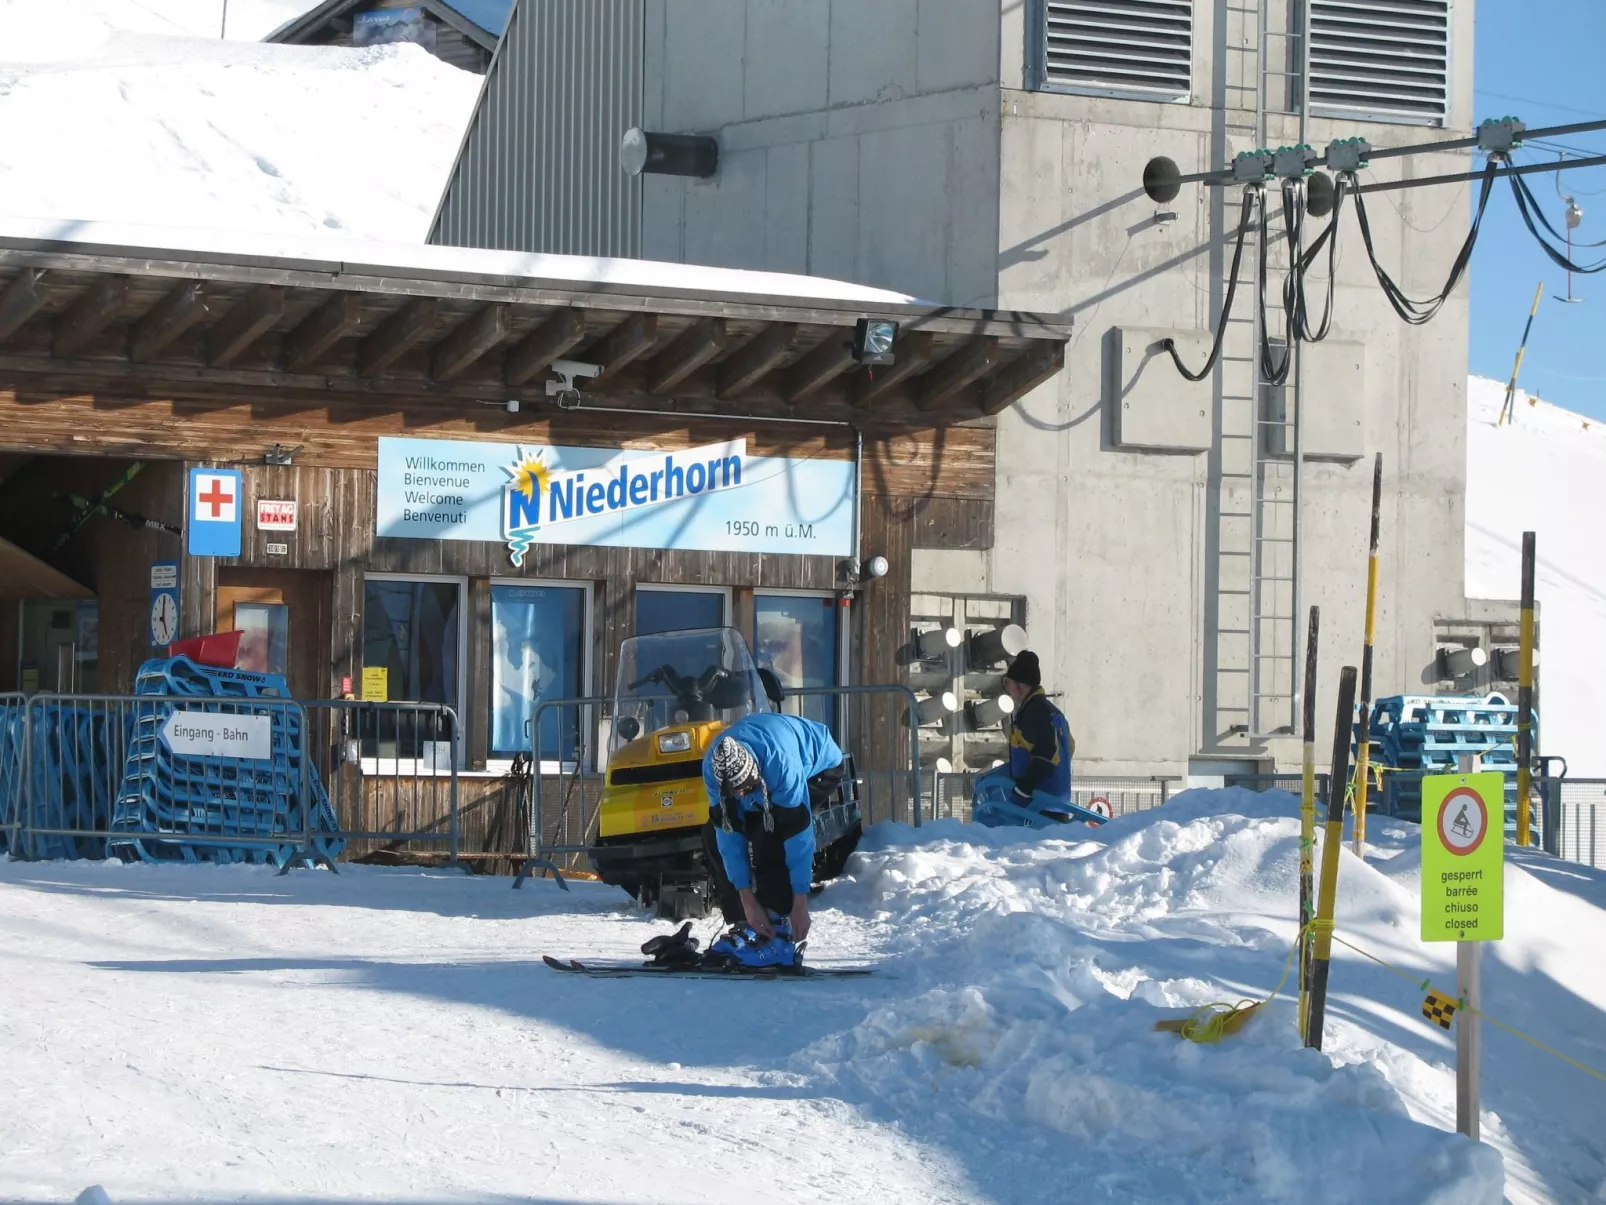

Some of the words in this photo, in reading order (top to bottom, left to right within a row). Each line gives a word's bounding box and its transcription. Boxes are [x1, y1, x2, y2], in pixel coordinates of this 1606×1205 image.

[405, 456, 485, 473] Willkommen
[404, 472, 470, 488] Bienvenue
[549, 454, 742, 523] Niederhorn
[404, 490, 464, 506] Welcome
[260, 513, 294, 523] STANS
[403, 508, 468, 524] Benvenuti
[725, 520, 760, 537] 1950
[765, 525, 779, 538] m
[784, 523, 817, 540] ü.M.
[173, 724, 214, 743] Eingang
[223, 727, 249, 742] Bahn
[1441, 869, 1483, 884] gesperrt
[1445, 885, 1478, 897] barrée
[1444, 902, 1479, 913] chiuso
[1444, 917, 1478, 929] closed
